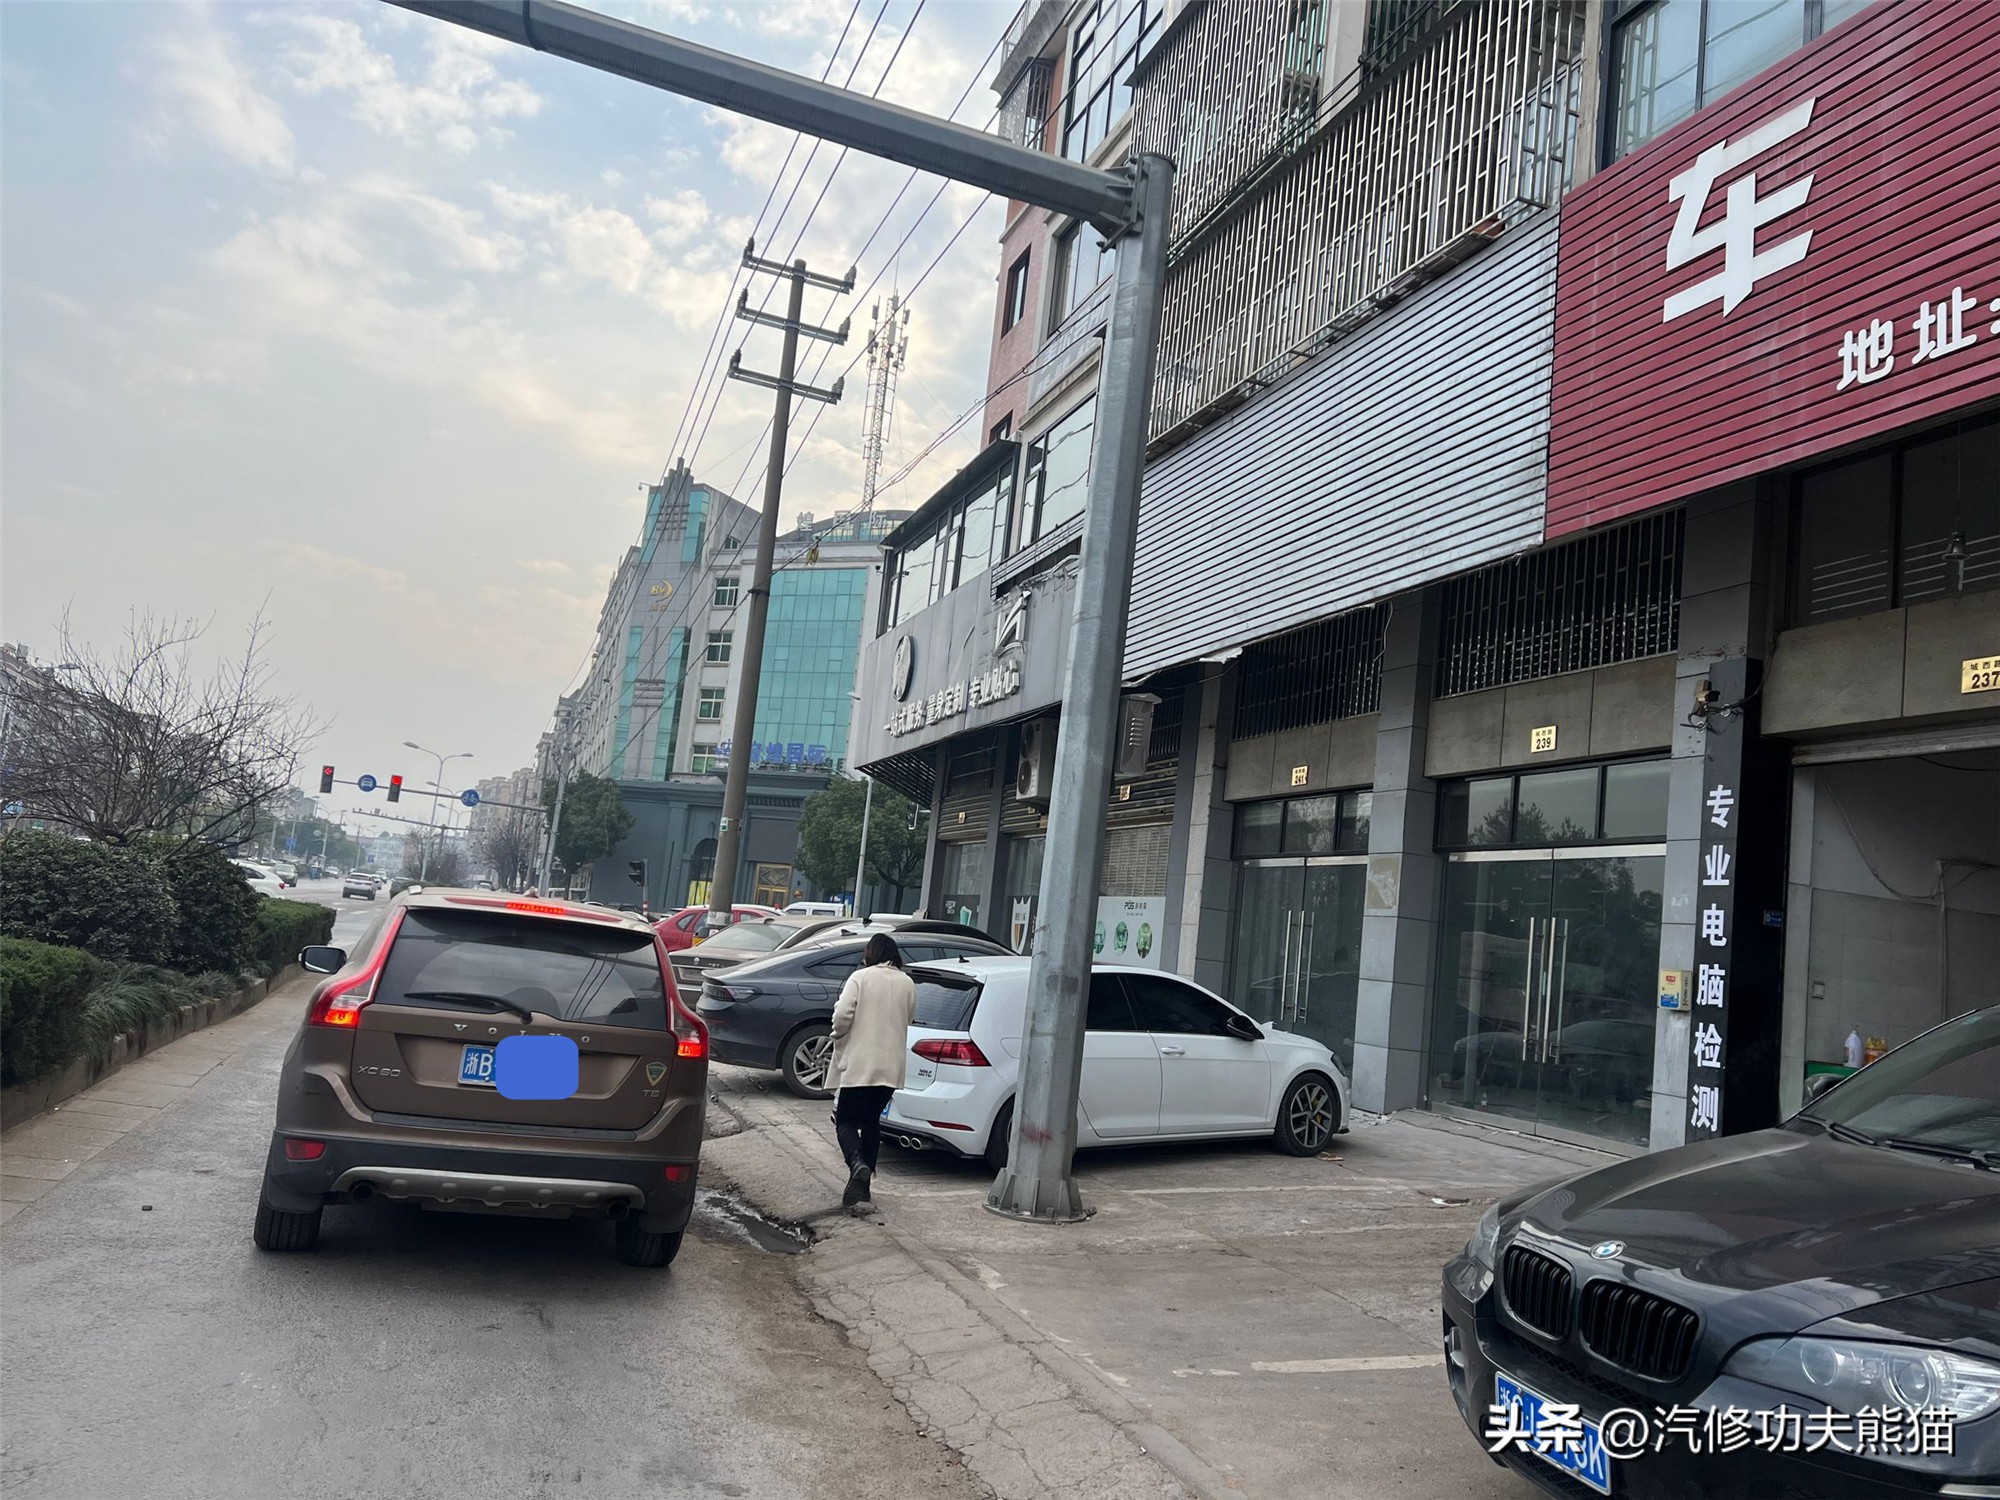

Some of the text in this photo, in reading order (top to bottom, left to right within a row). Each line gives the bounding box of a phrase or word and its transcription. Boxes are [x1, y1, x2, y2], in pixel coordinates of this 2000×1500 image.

[1663, 97, 1816, 324] 车
[926, 679, 967, 725] 量身定制
[968, 659, 1020, 709] 专业贴心
[1971, 671, 2000, 689] 237
[1536, 737, 1551, 750] 239
[1690, 783, 1735, 1132] 专业电脑检测
